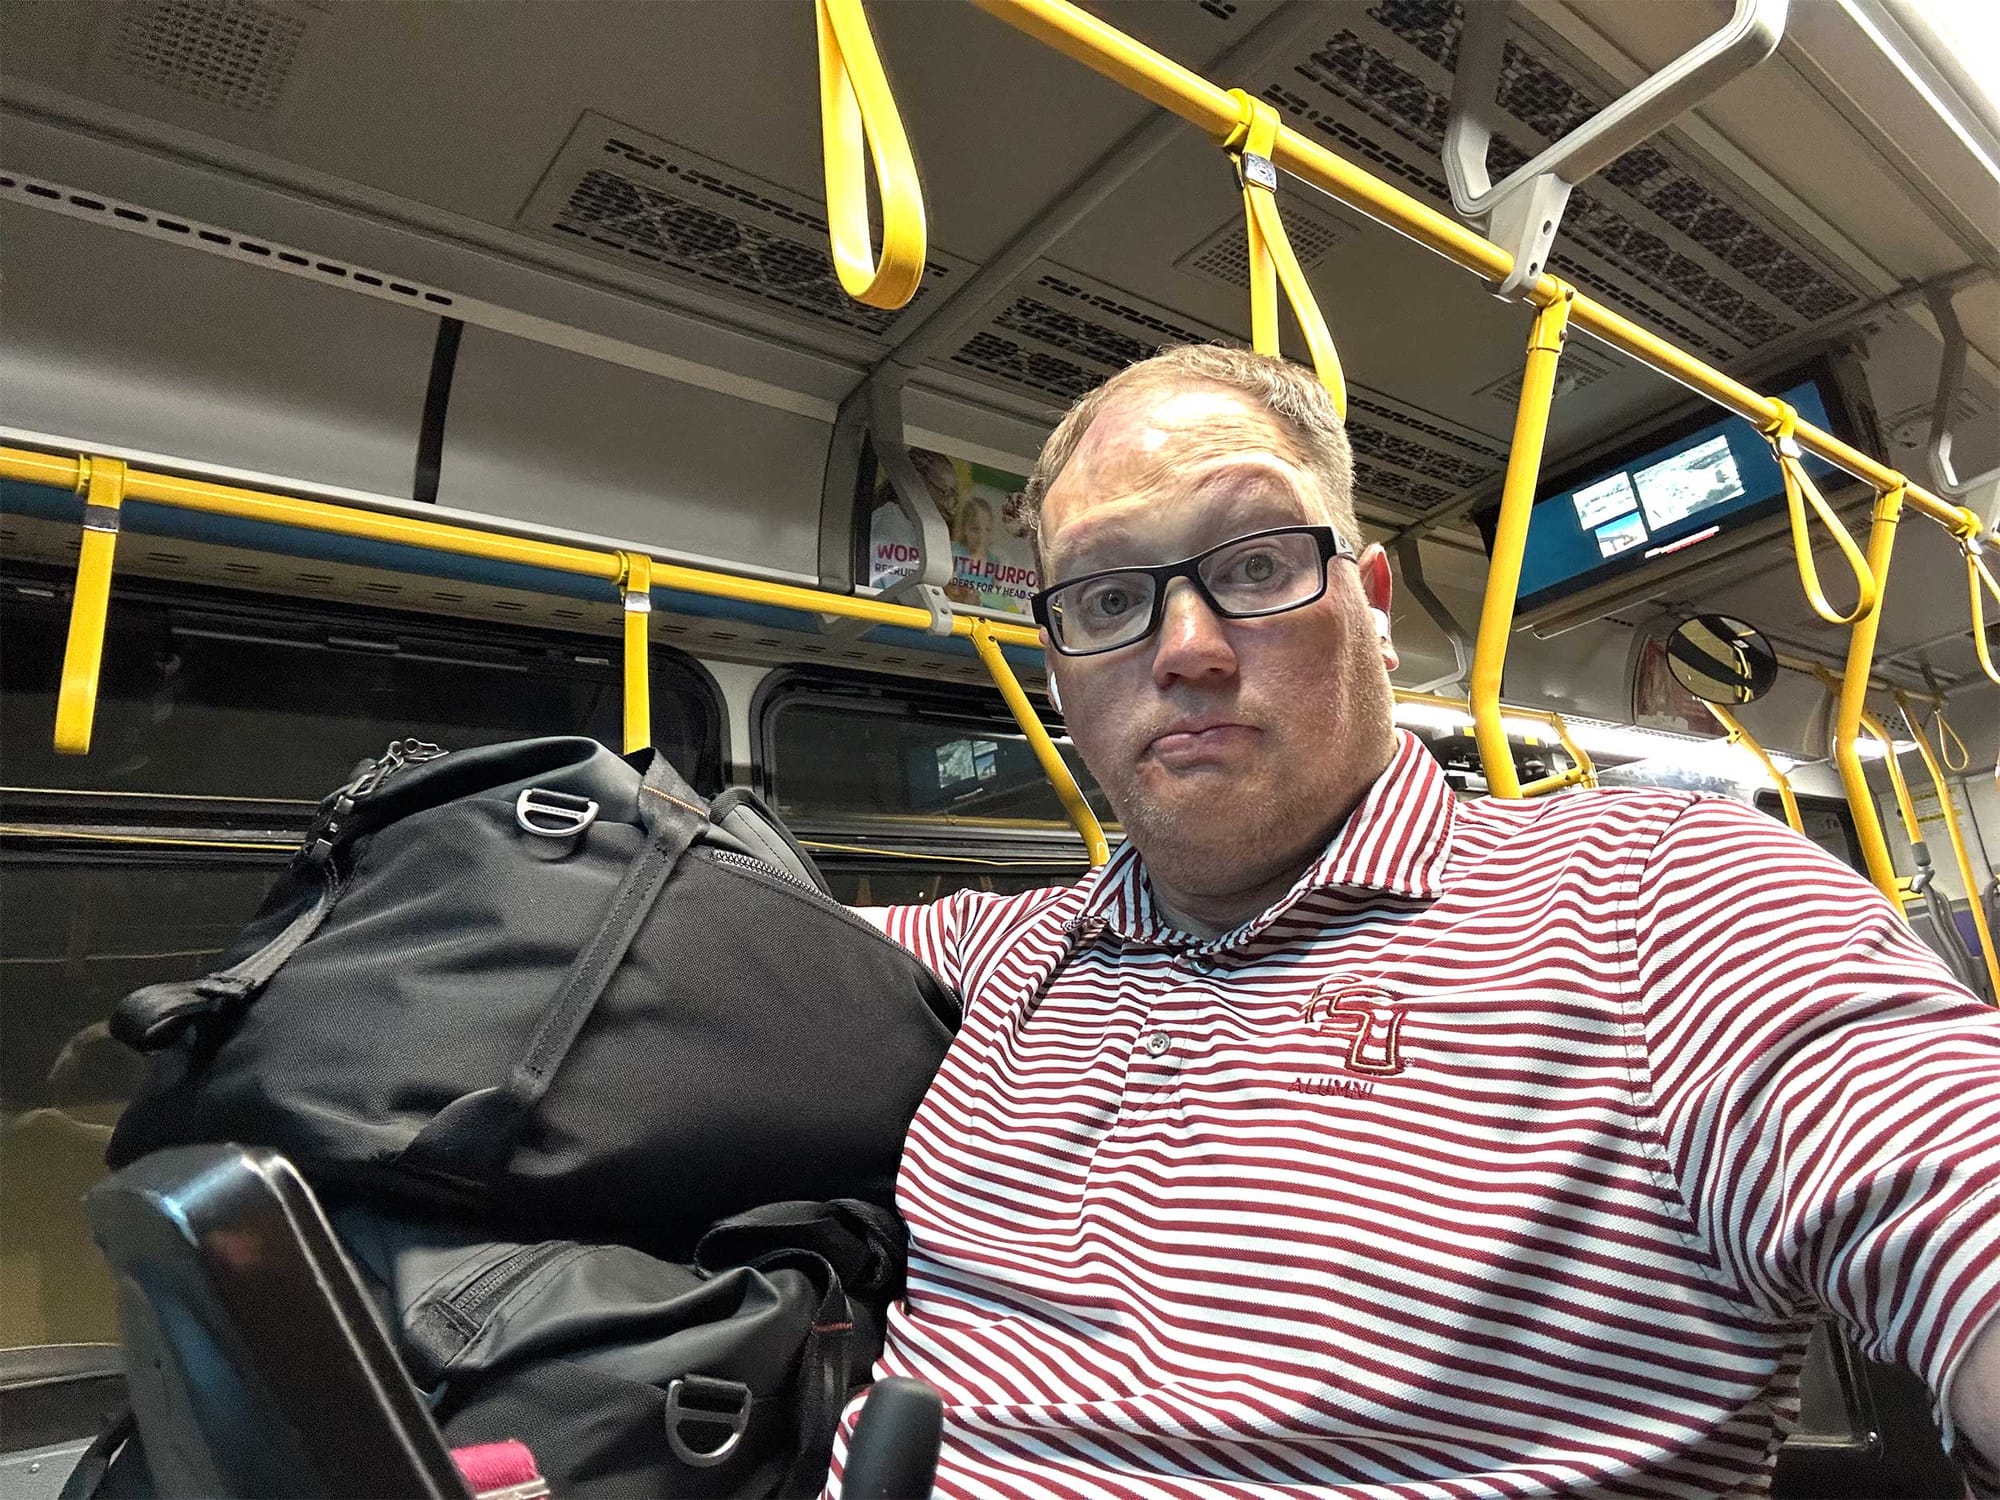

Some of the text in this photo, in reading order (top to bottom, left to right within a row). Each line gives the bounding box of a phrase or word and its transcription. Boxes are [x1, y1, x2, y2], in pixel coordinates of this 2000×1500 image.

[877, 543, 1040, 588] WOR ITH PURPO
[952, 577, 975, 589] DERS
[976, 582, 993, 593] FOR
[1003, 587, 1026, 599] HEAD
[1288, 1077, 1375, 1099] ALUMNI
